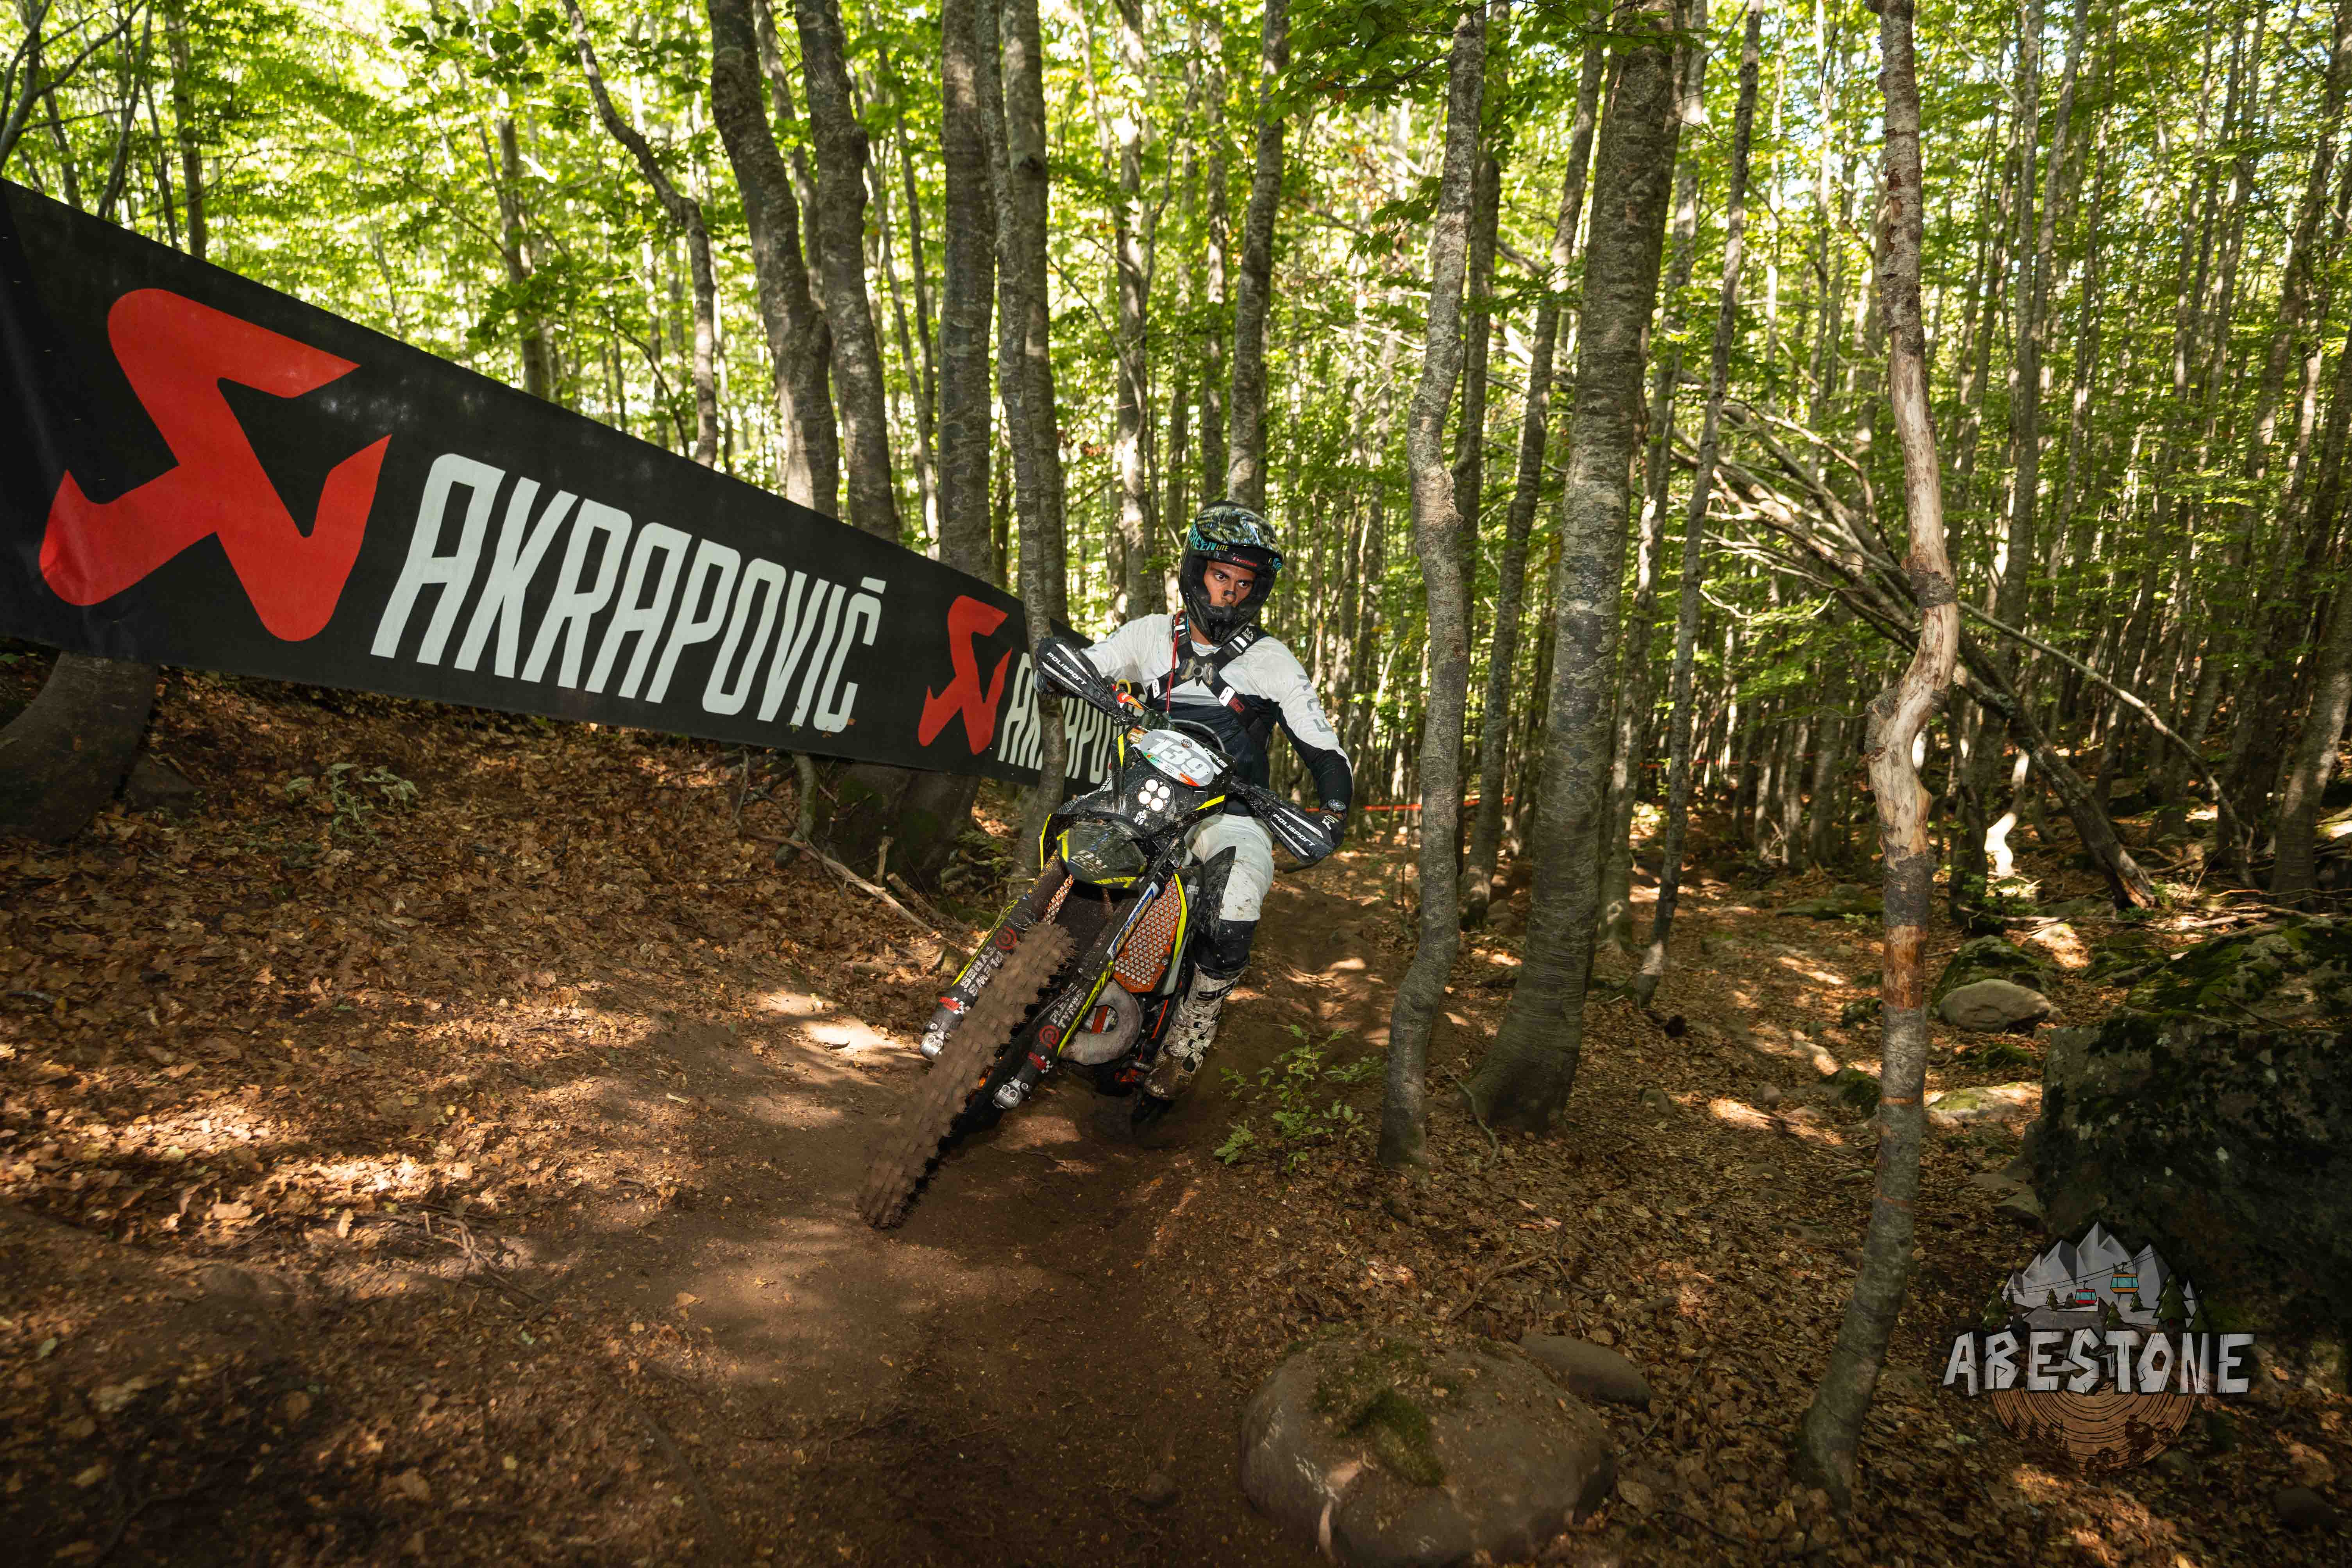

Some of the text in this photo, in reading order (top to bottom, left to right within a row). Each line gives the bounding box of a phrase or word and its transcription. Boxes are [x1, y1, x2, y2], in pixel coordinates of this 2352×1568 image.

[1047, 652, 1087, 685] POLISPORT
[1148, 738, 1211, 779] 139
[1273, 814, 1316, 846] POLISPORT
